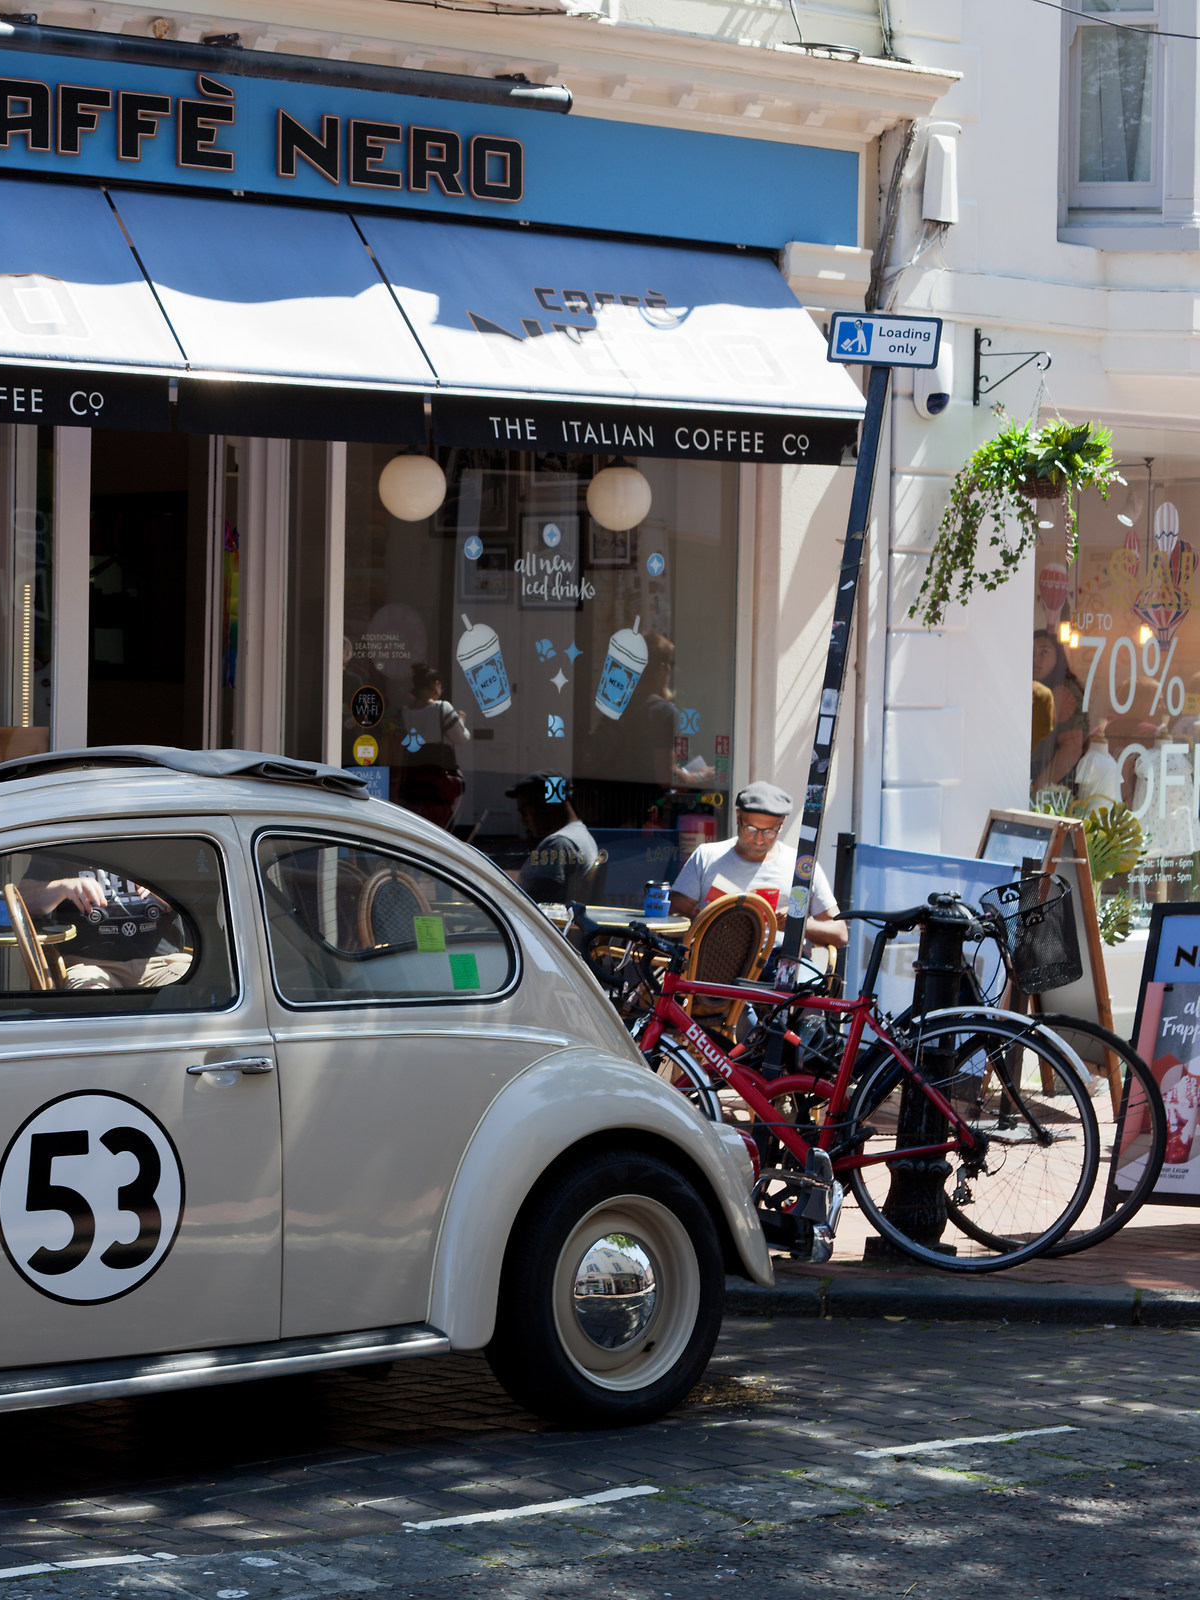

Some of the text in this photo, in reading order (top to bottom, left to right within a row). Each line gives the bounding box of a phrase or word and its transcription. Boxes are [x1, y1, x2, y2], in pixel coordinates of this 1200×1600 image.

[276, 107, 524, 203] NERO
[878, 326, 932, 344] Loading
[888, 341, 917, 357] only
[489, 417, 538, 441] THE
[562, 420, 655, 448] ITALIAN
[675, 427, 765, 454] COFFEE
[514, 551, 576, 577] all new
[551, 573, 597, 601] drinks
[1077, 613, 1113, 631] UP TO
[355, 642, 406, 650] SEATING AT THE
[361, 633, 400, 641] ADDITIONAL
[351, 651, 366, 659] ACK
[368, 651, 376, 659] OF
[378, 651, 390, 659] THE
[480, 675, 497, 689] NERO
[609, 677, 624, 691] NERO
[1077, 636, 1185, 717] 70%
[358, 694, 376, 705] FREE
[355, 705, 379, 717] WI-FI
[1116, 743, 1200, 820] OF
[530, 848, 609, 866] ESPRESO
[1179, 858, 1194, 869] 6pm
[1177, 872, 1192, 883] 5pm
[1174, 945, 1200, 967] N
[26, 1126, 162, 1275] 53
